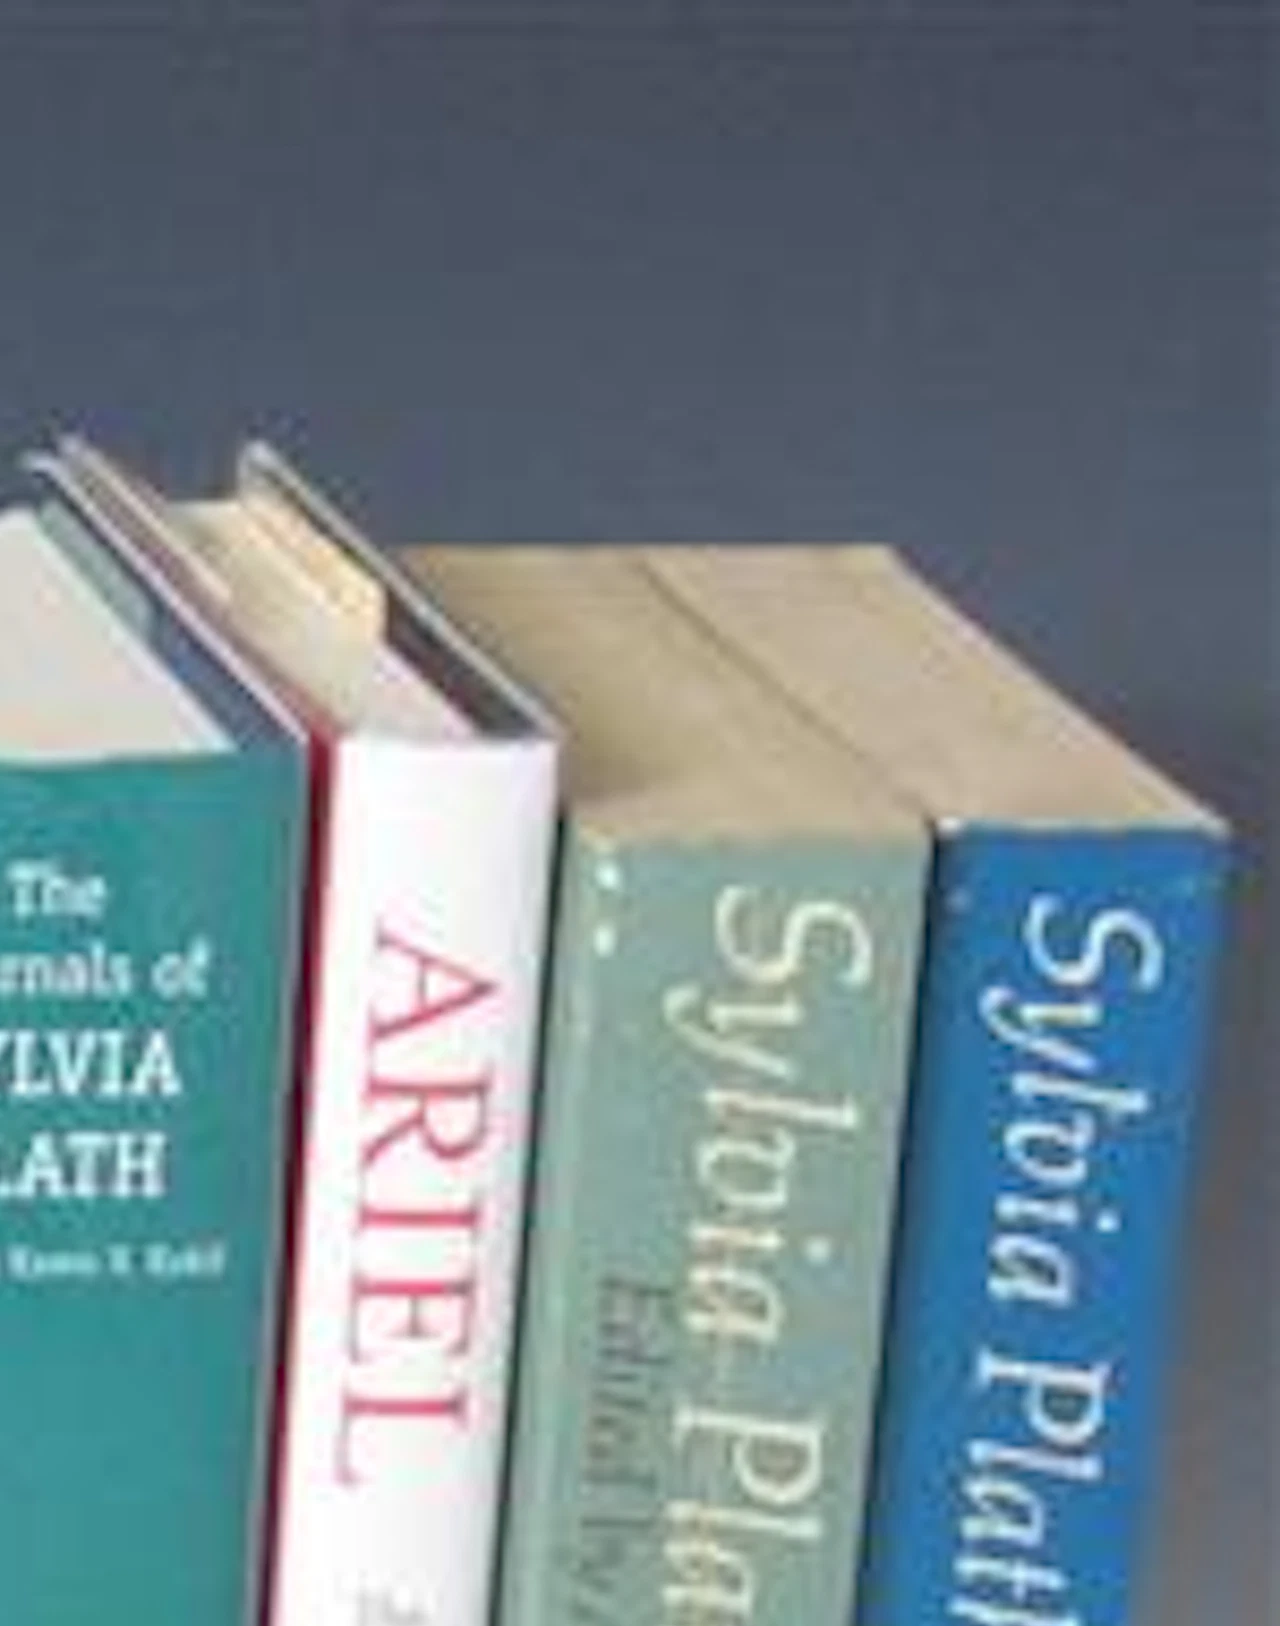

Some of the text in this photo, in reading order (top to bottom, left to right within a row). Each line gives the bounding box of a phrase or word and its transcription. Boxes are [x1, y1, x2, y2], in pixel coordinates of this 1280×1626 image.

[5, 858, 107, 917] The
[149, 935, 212, 998] of
[335, 912, 504, 1490] ARIEL
[662, 880, 878, 1348] Sylvia
[980, 890, 1168, 1308] Sylvia
